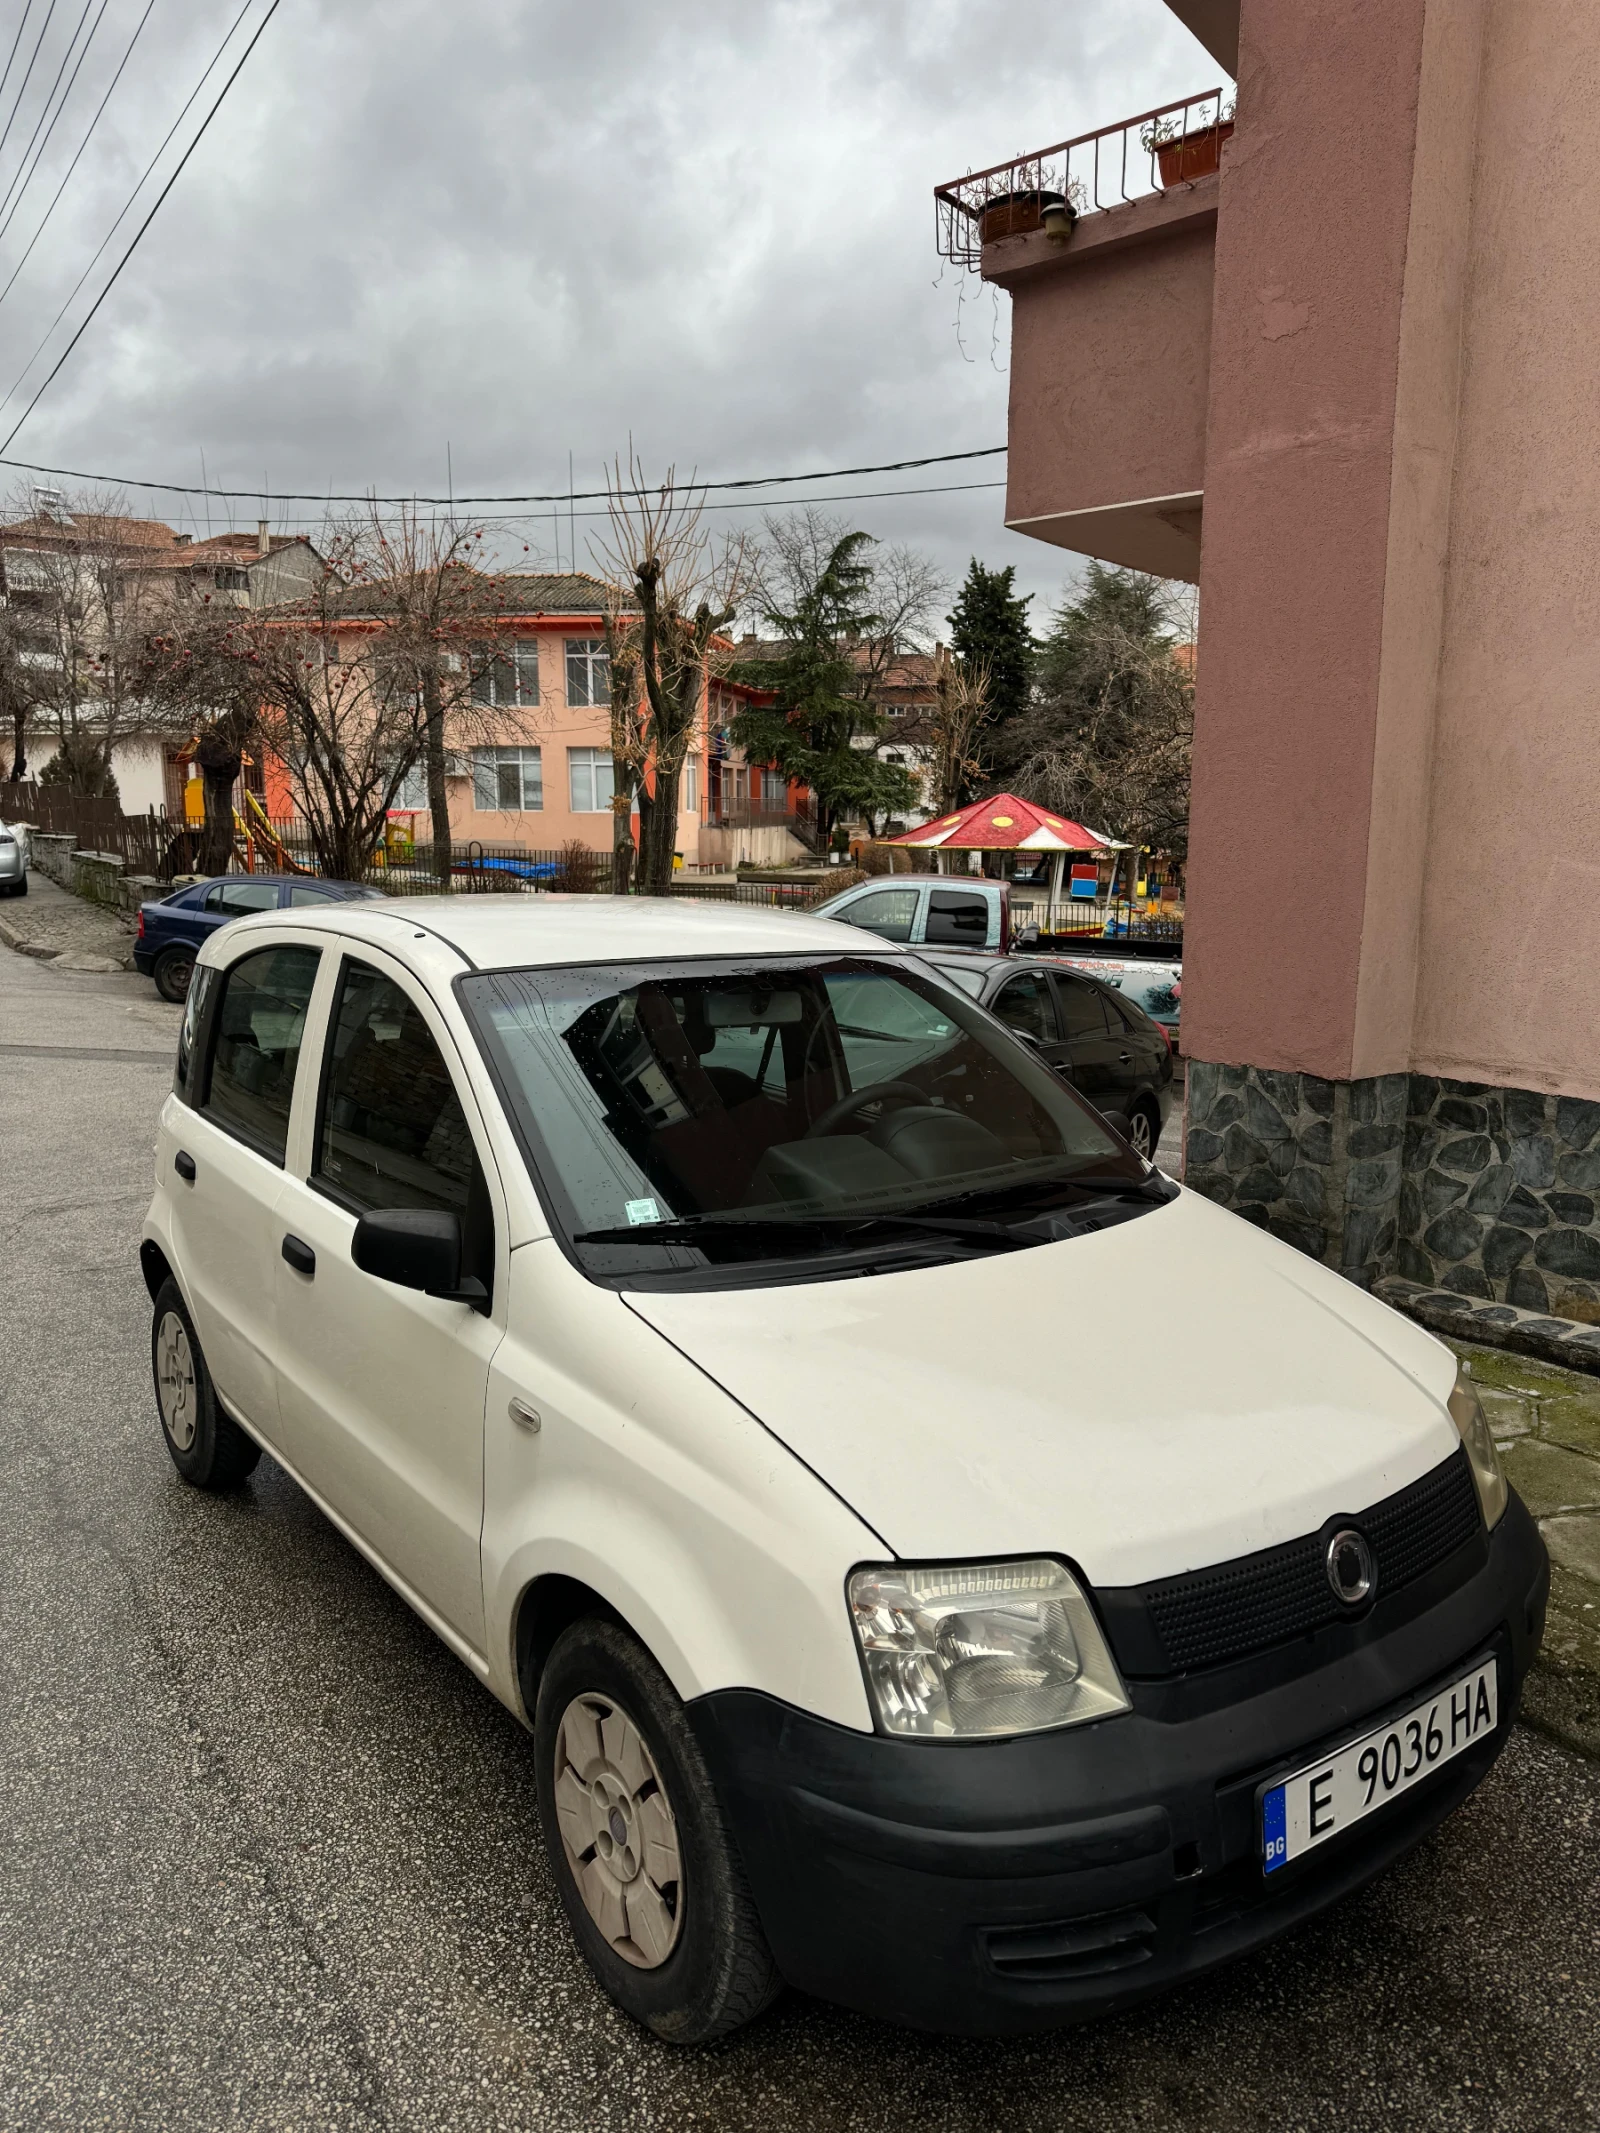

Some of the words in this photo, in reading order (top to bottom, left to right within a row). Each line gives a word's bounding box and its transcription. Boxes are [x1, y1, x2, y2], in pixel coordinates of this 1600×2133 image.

[1309, 1768, 1334, 1839] E
[1357, 1704, 1443, 1806] 9036
[1451, 1674, 1491, 1748] HA
[1266, 1836, 1285, 1860] BG
